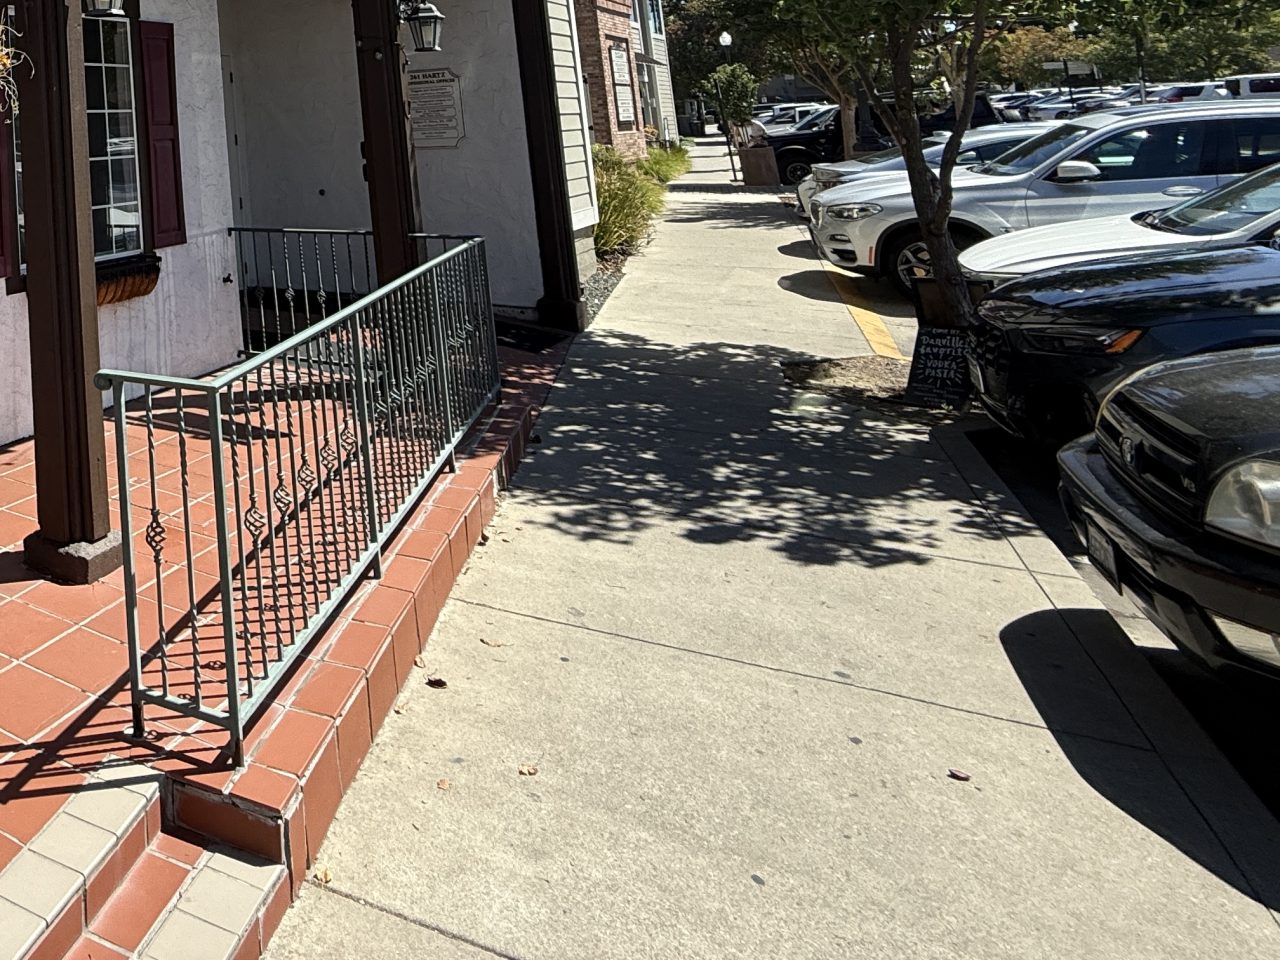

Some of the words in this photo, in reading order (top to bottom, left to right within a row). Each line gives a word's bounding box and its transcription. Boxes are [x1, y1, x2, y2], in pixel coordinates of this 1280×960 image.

[422, 72, 446, 80] HARTZ
[926, 359, 957, 370] VODKA
[924, 368, 955, 379] PASTA
